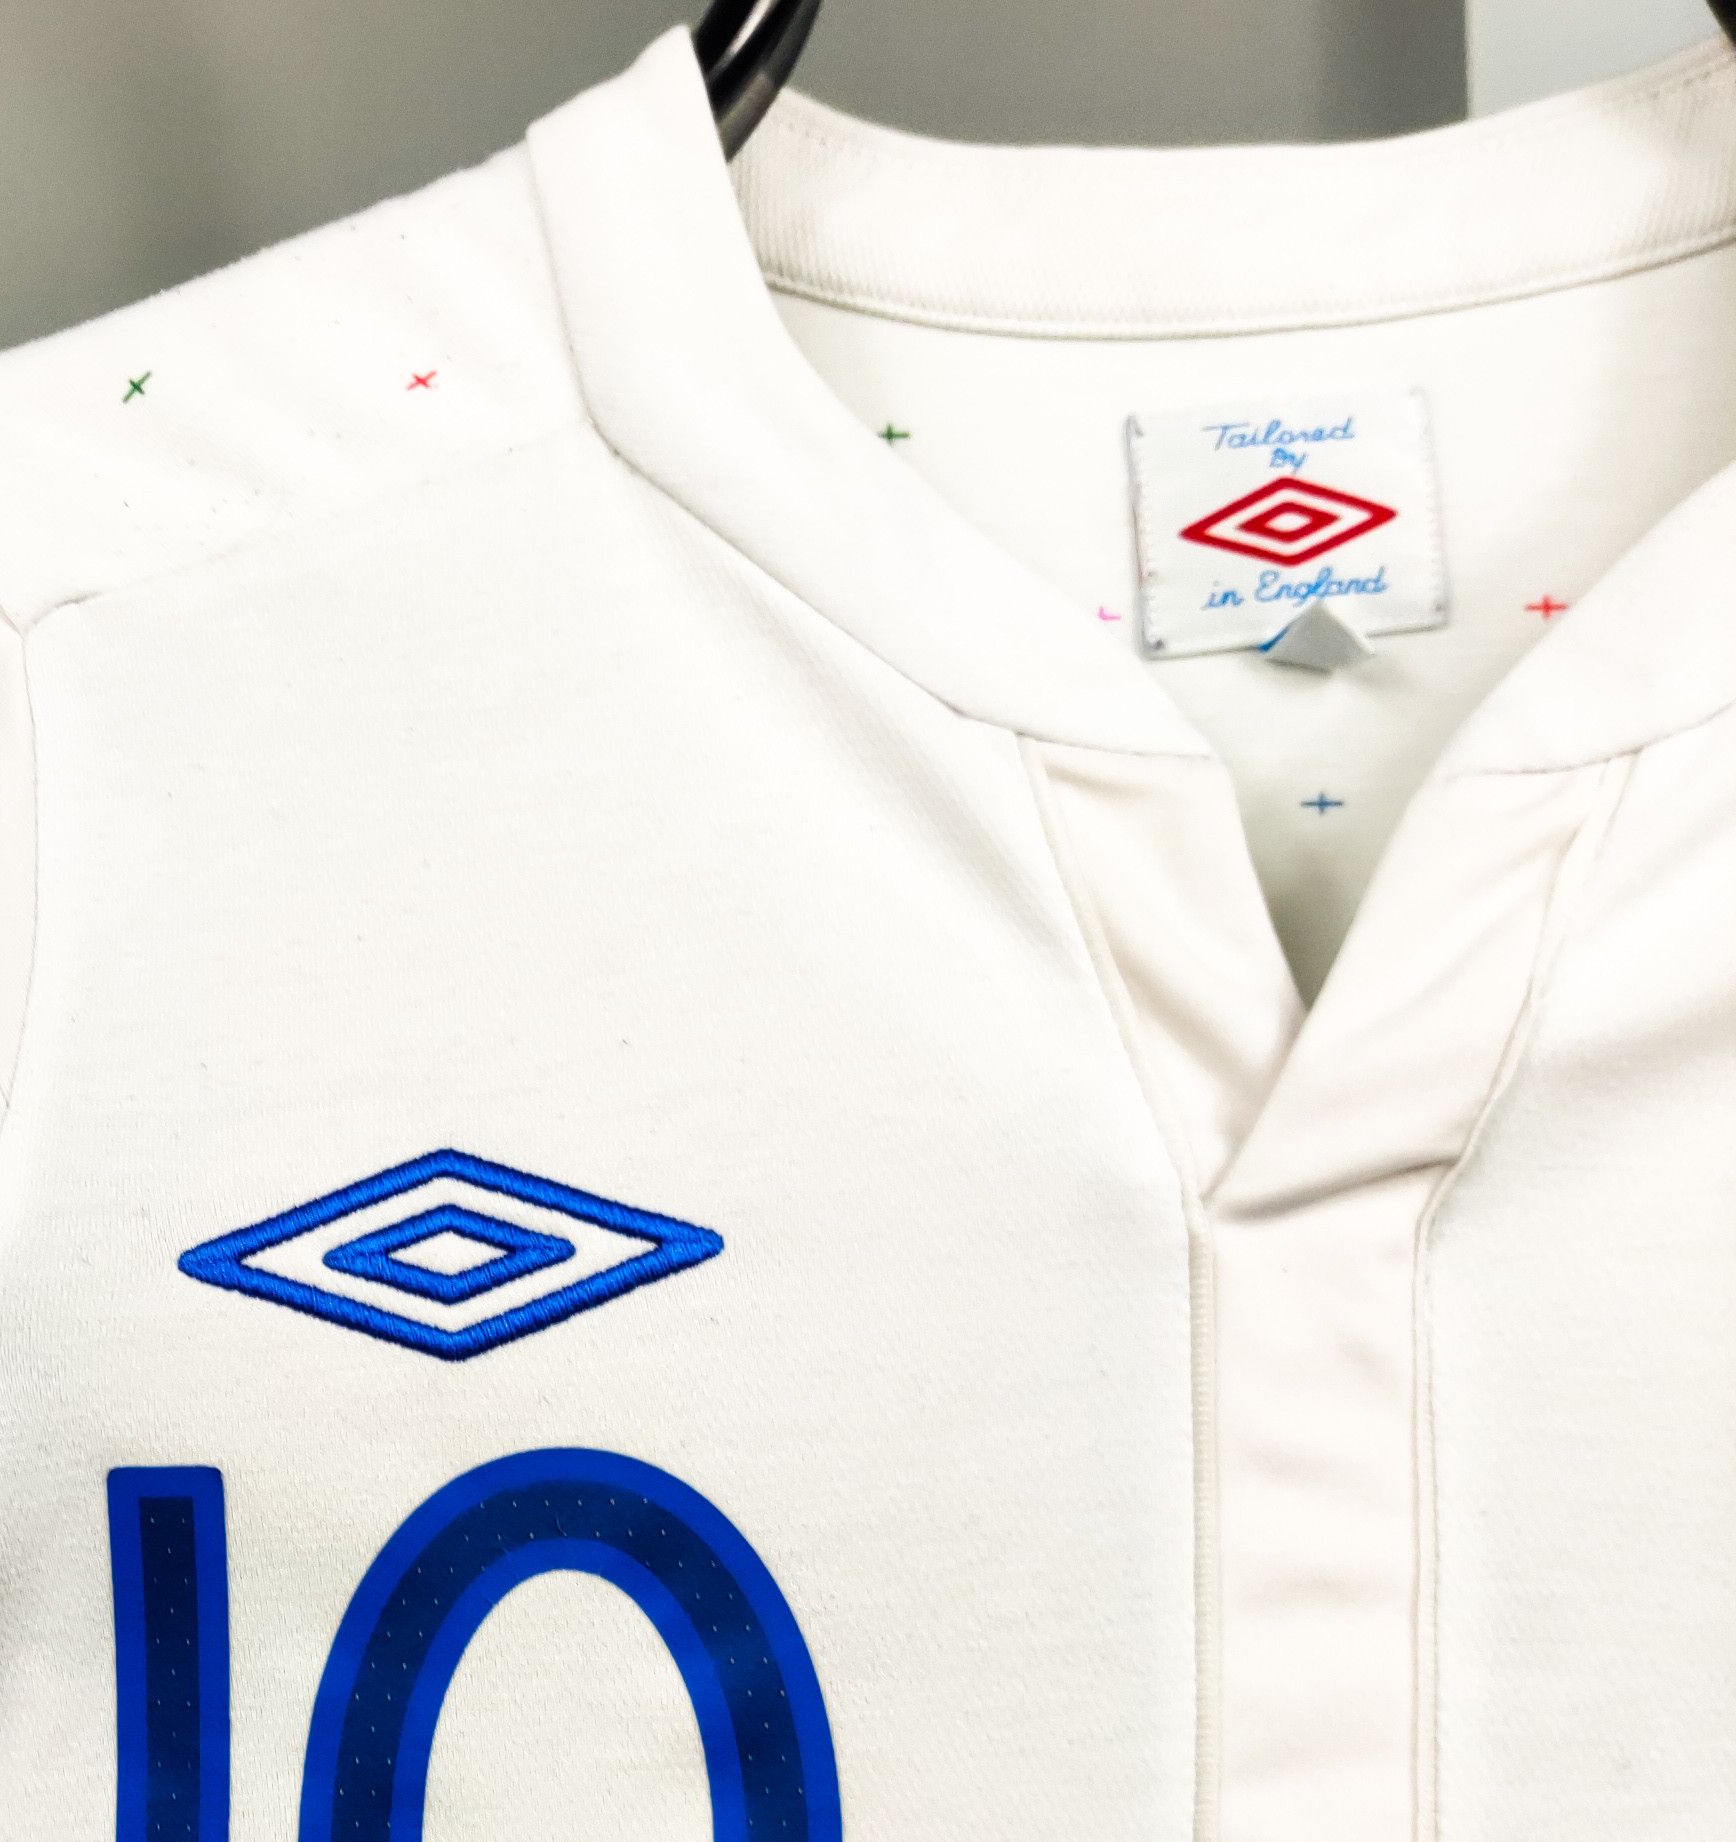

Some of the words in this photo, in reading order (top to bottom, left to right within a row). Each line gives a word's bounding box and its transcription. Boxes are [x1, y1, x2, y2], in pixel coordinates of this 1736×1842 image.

[1202, 417, 1356, 451] Tailored
[1204, 582, 1245, 609] in
[1254, 566, 1388, 606] England
